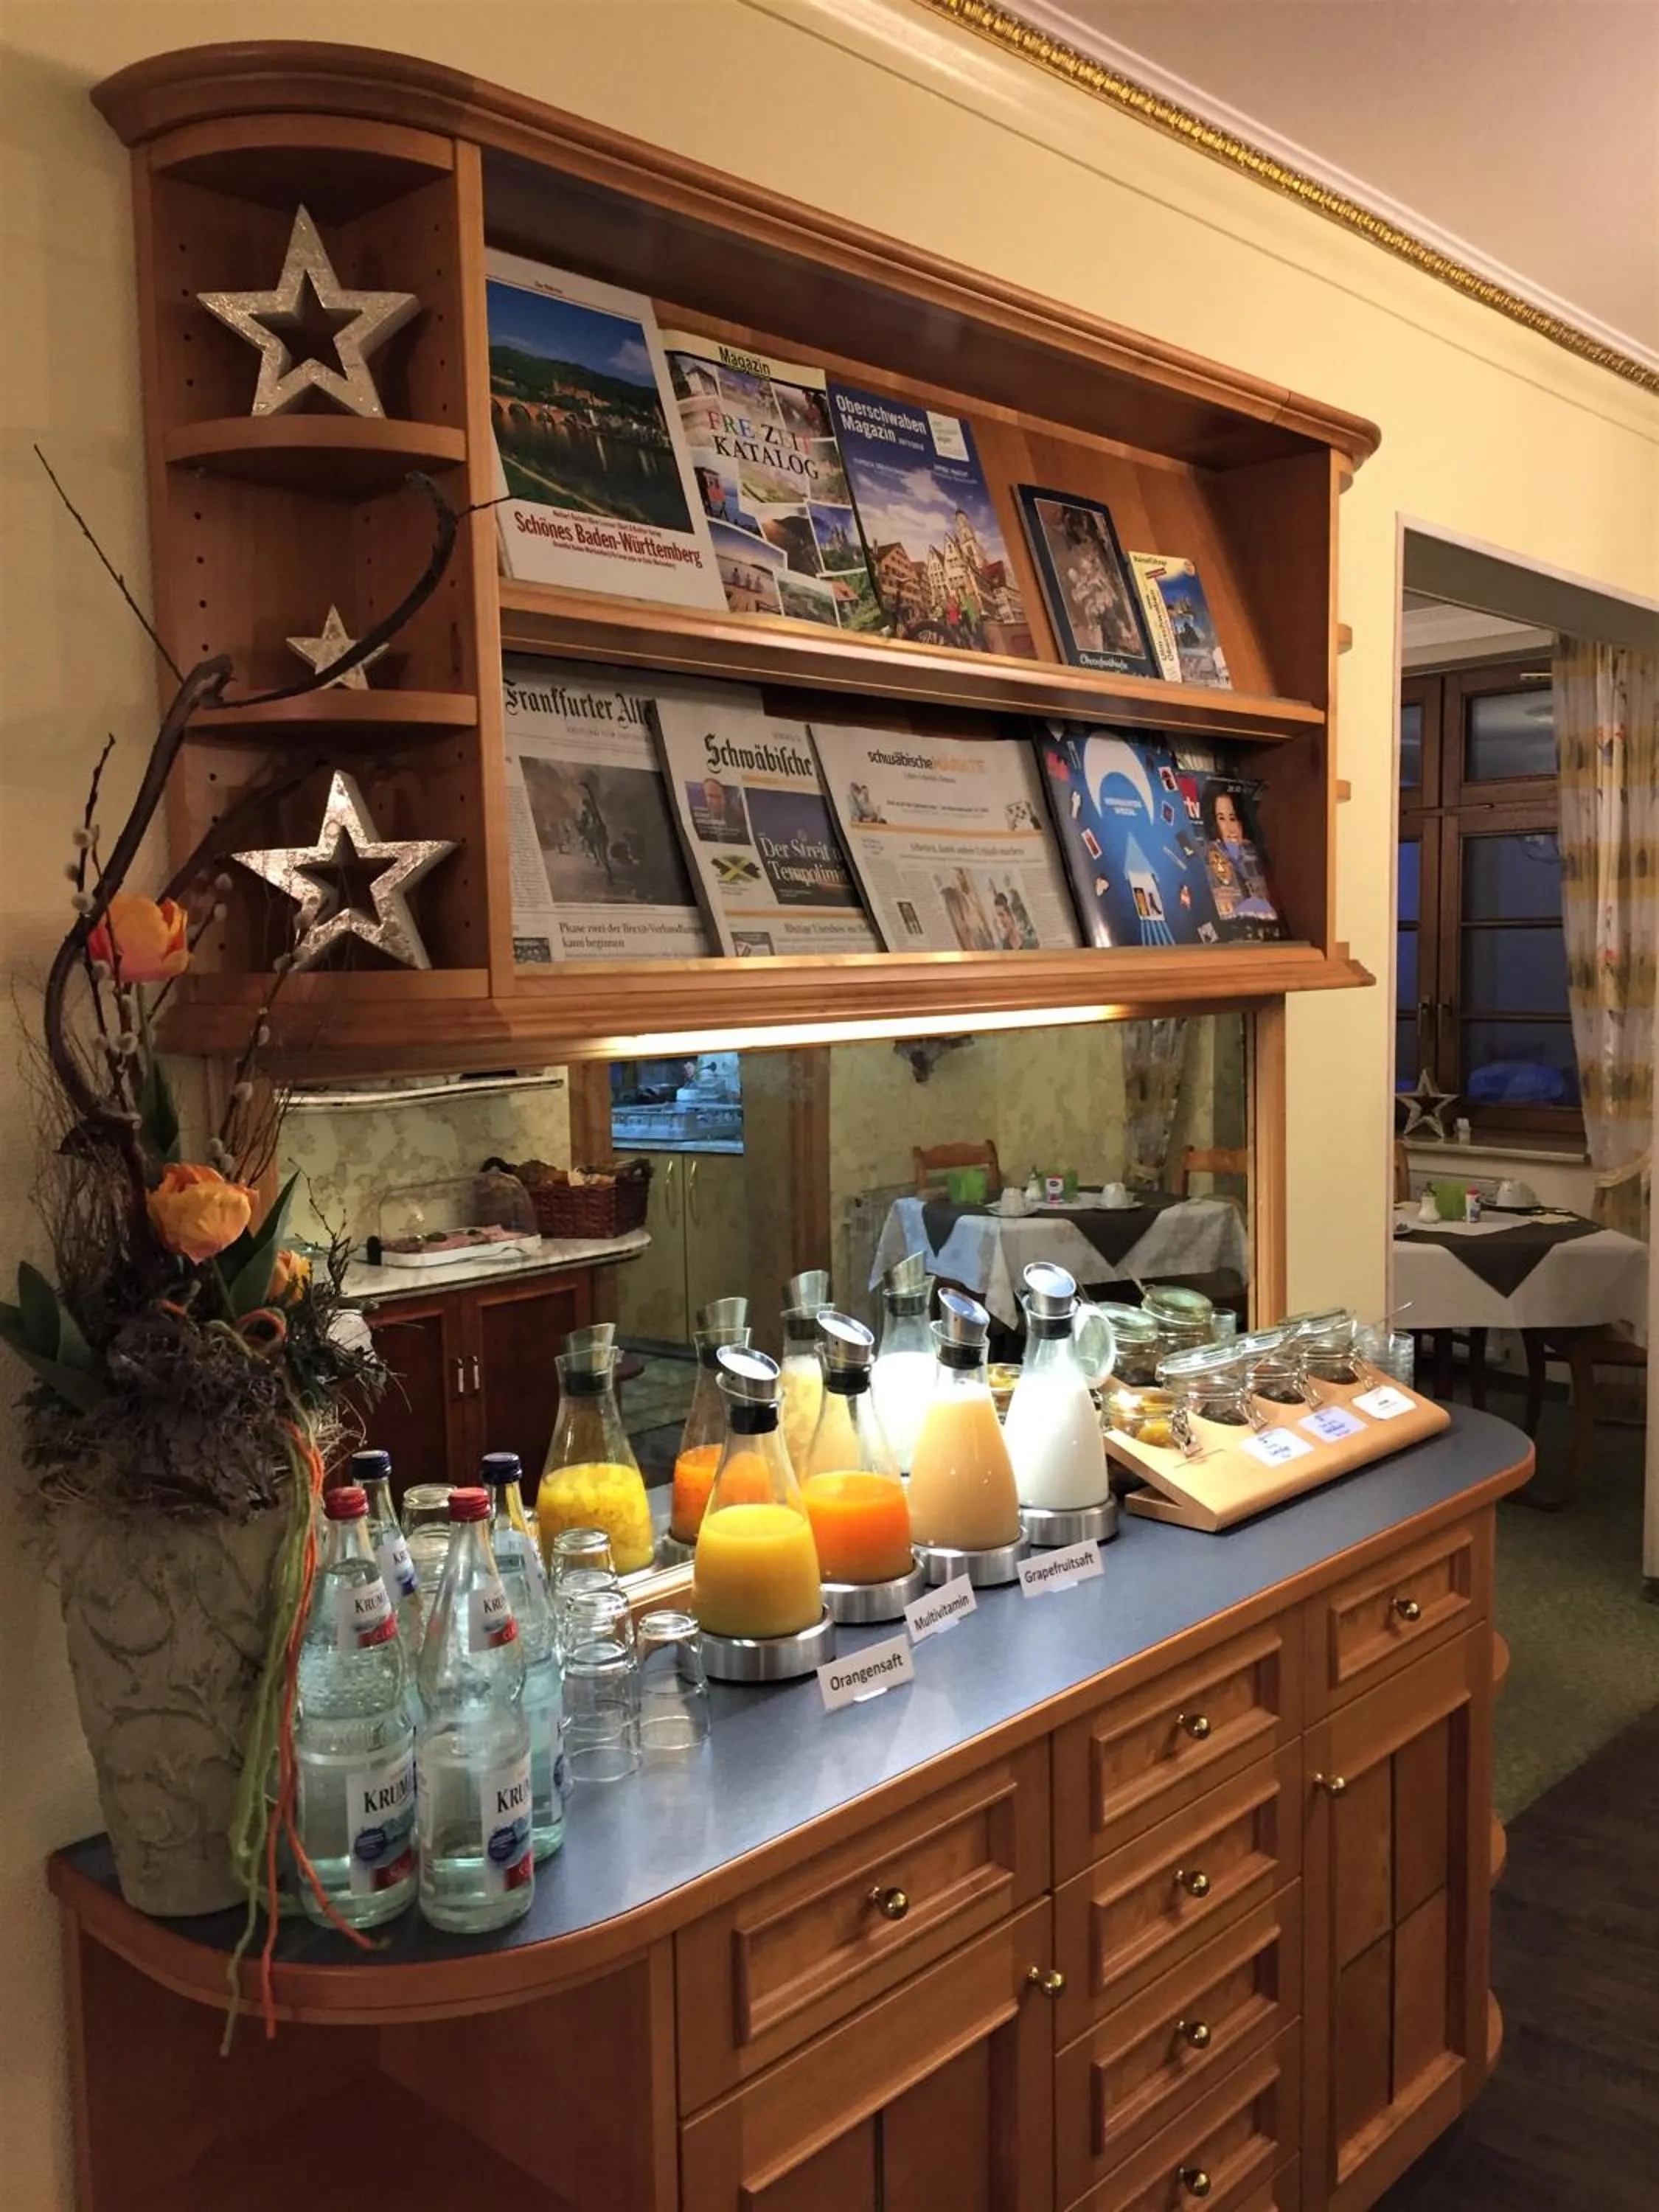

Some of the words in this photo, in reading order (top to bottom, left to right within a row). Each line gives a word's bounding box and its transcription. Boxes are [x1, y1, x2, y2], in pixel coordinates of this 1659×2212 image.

[718, 347, 771, 375] Magazin
[835, 394, 927, 435] Oberschwaben
[840, 414, 897, 442] Magazin
[712, 435, 818, 479] KATALOG
[514, 511, 573, 541] Schönes
[574, 523, 703, 568] Baden-Württemberg
[503, 678, 613, 720] Frankfurter
[704, 733, 813, 776] Schwäbische
[758, 837, 790, 859] Der
[790, 838, 831, 861] Streit
[1024, 1551, 1094, 1584] Grapefruitsaft
[914, 1594, 970, 1631] Multivitamin
[830, 1653, 904, 1691] Orangensaft
